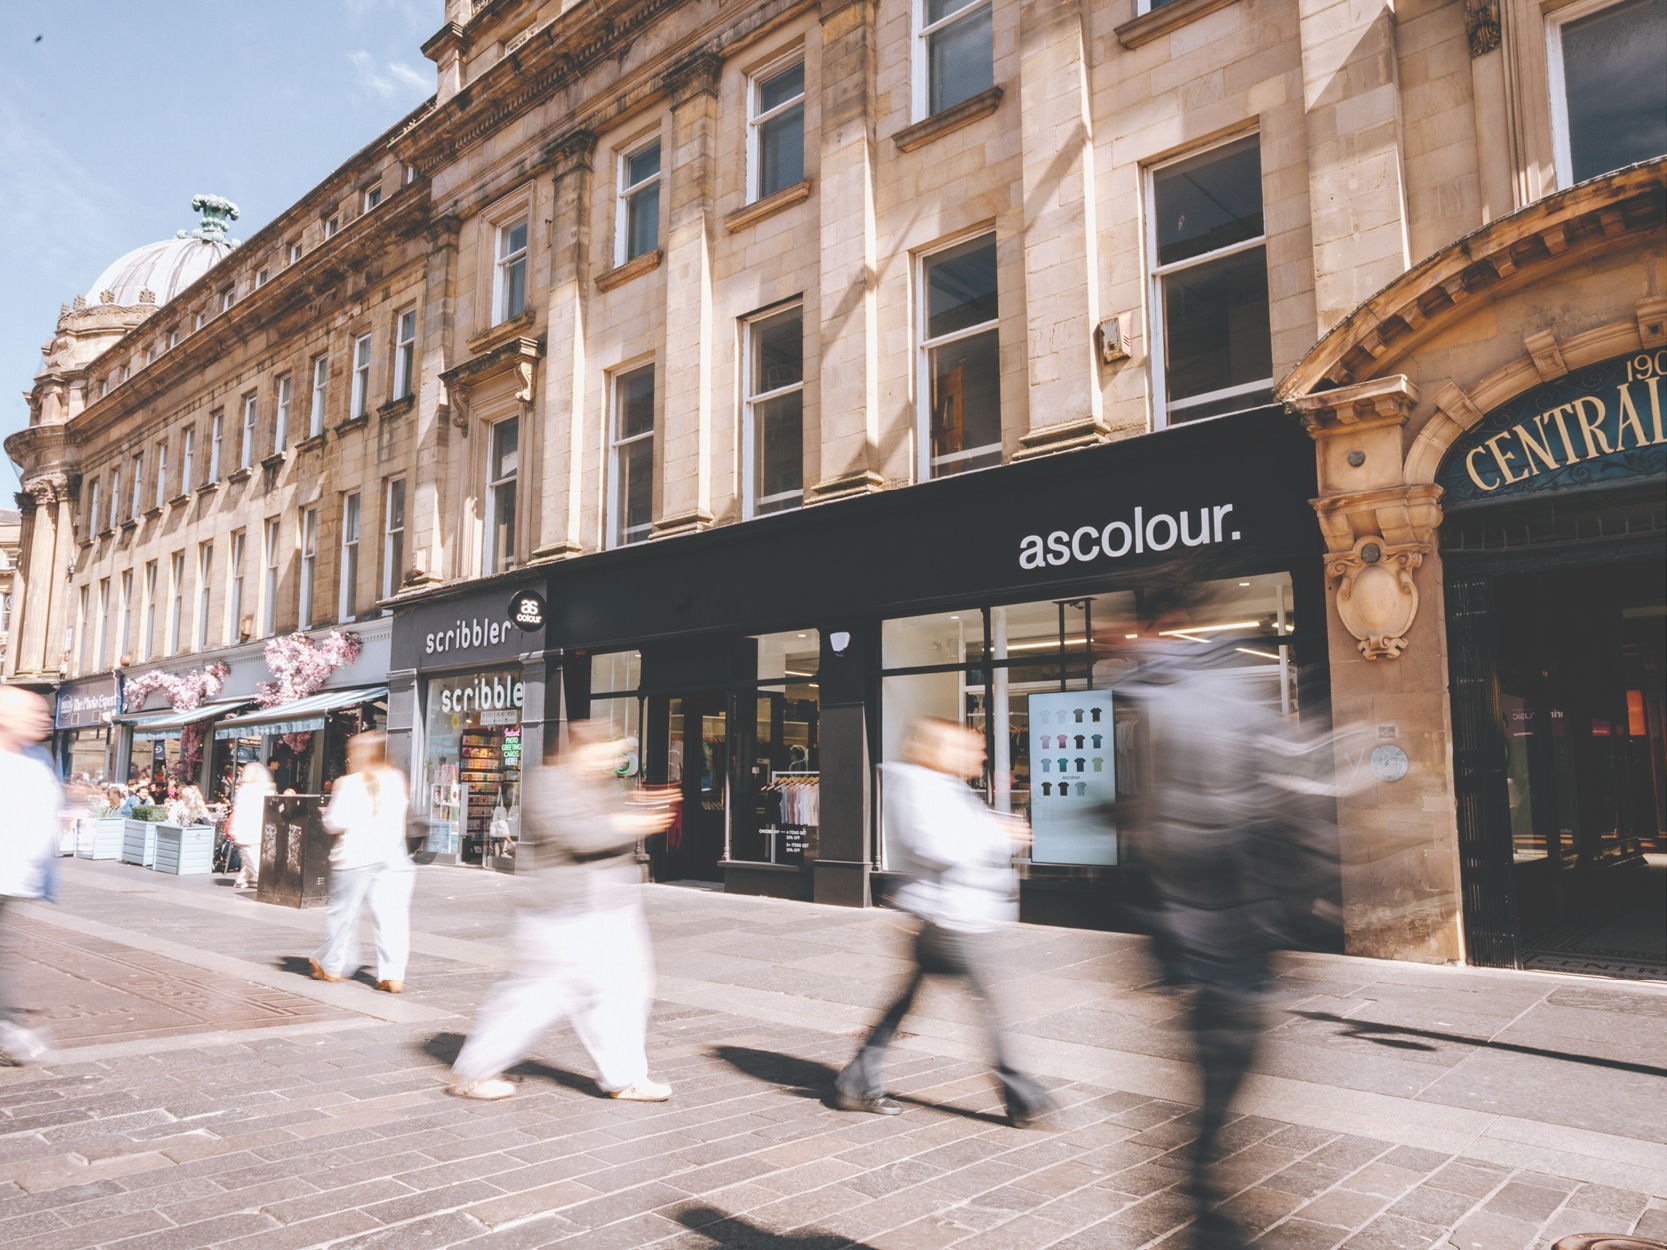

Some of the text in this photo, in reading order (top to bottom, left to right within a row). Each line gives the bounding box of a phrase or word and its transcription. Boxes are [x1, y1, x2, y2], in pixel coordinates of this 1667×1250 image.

[1466, 376, 1667, 491] CENTRAL
[1019, 503, 1241, 570] ascolour.
[426, 618, 511, 654] scribbler
[516, 613, 542, 624] colour
